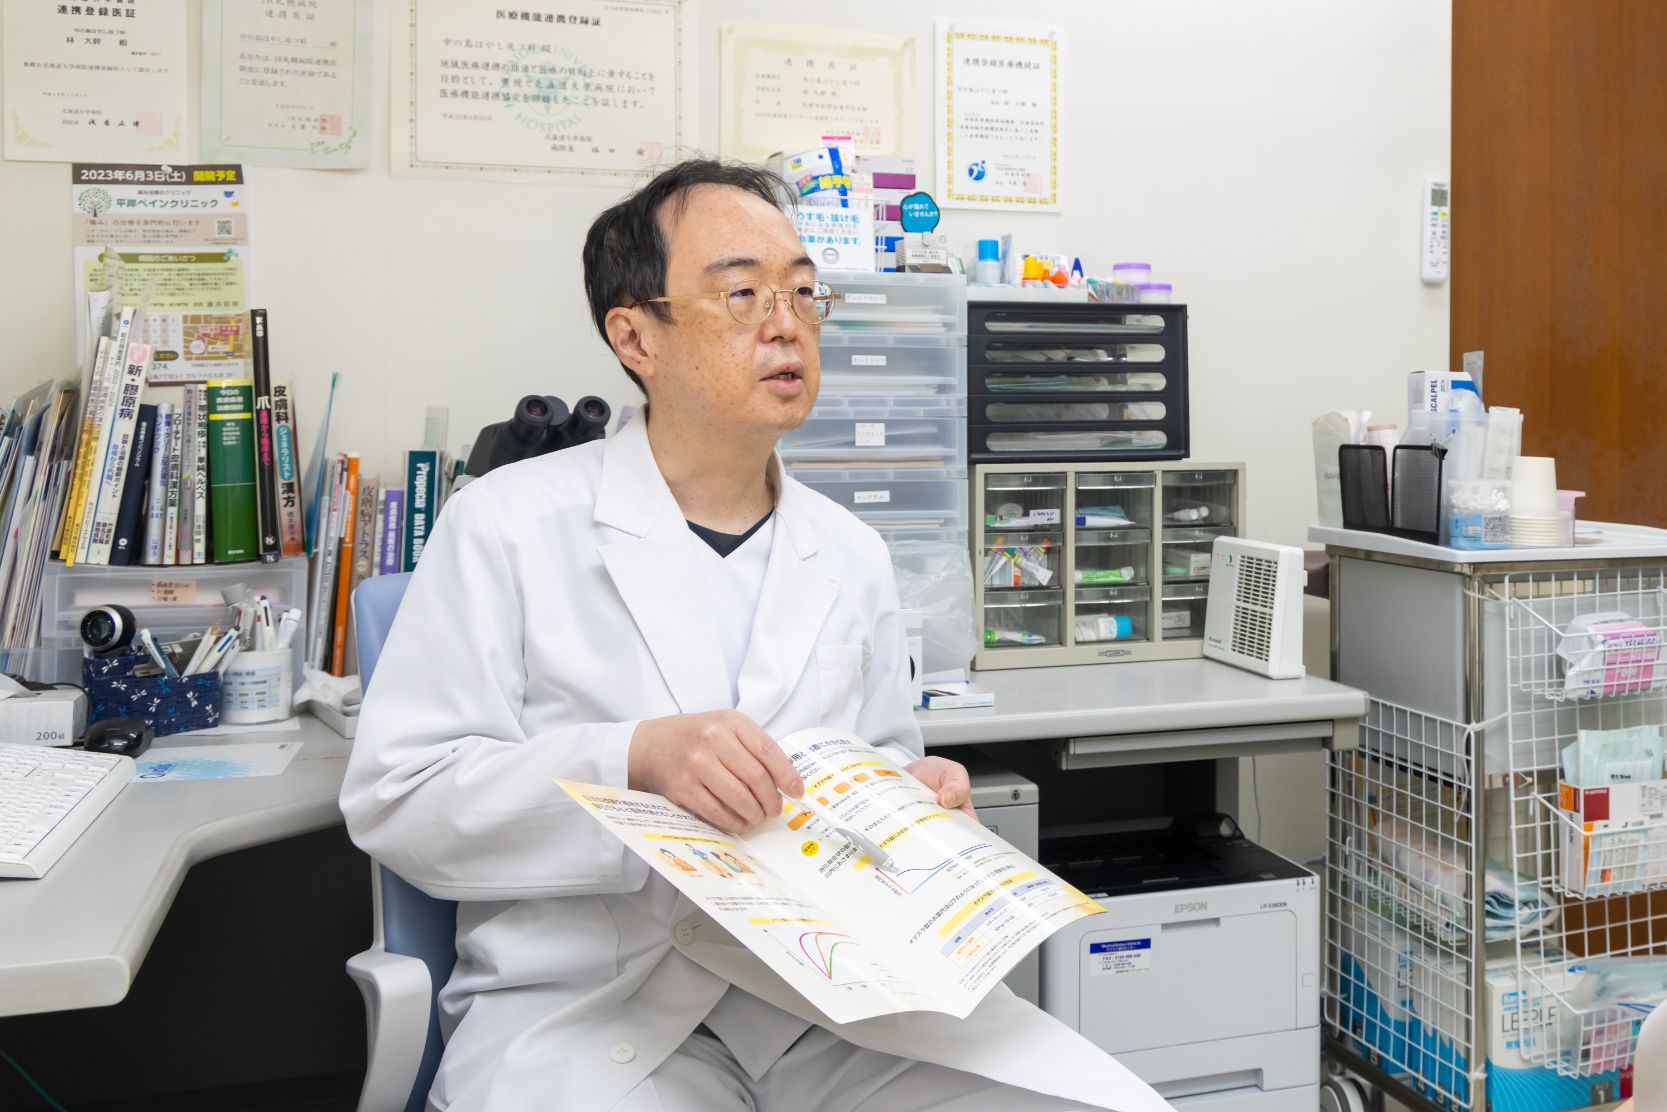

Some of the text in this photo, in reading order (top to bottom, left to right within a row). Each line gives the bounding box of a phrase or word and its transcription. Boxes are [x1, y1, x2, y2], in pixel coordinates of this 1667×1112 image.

[57, 6, 136, 18] 連携登録医証
[495, 10, 602, 27] 医療機能連携登録証
[515, 112, 583, 132] HOSPITAL
[80, 169, 186, 182] 2023年6月3日(土)
[116, 199, 219, 208] 平岸ペインクリニック
[119, 364, 142, 420] 新・膠原病
[1430, 379, 1438, 413] SCALPEL
[257, 397, 271, 409] 爪
[273, 385, 290, 424] 皮膚科
[281, 483, 296, 508] 漢方
[415, 463, 429, 508] Propecia
[413, 514, 425, 536] DATA
[1174, 901, 1208, 914] EPSON
